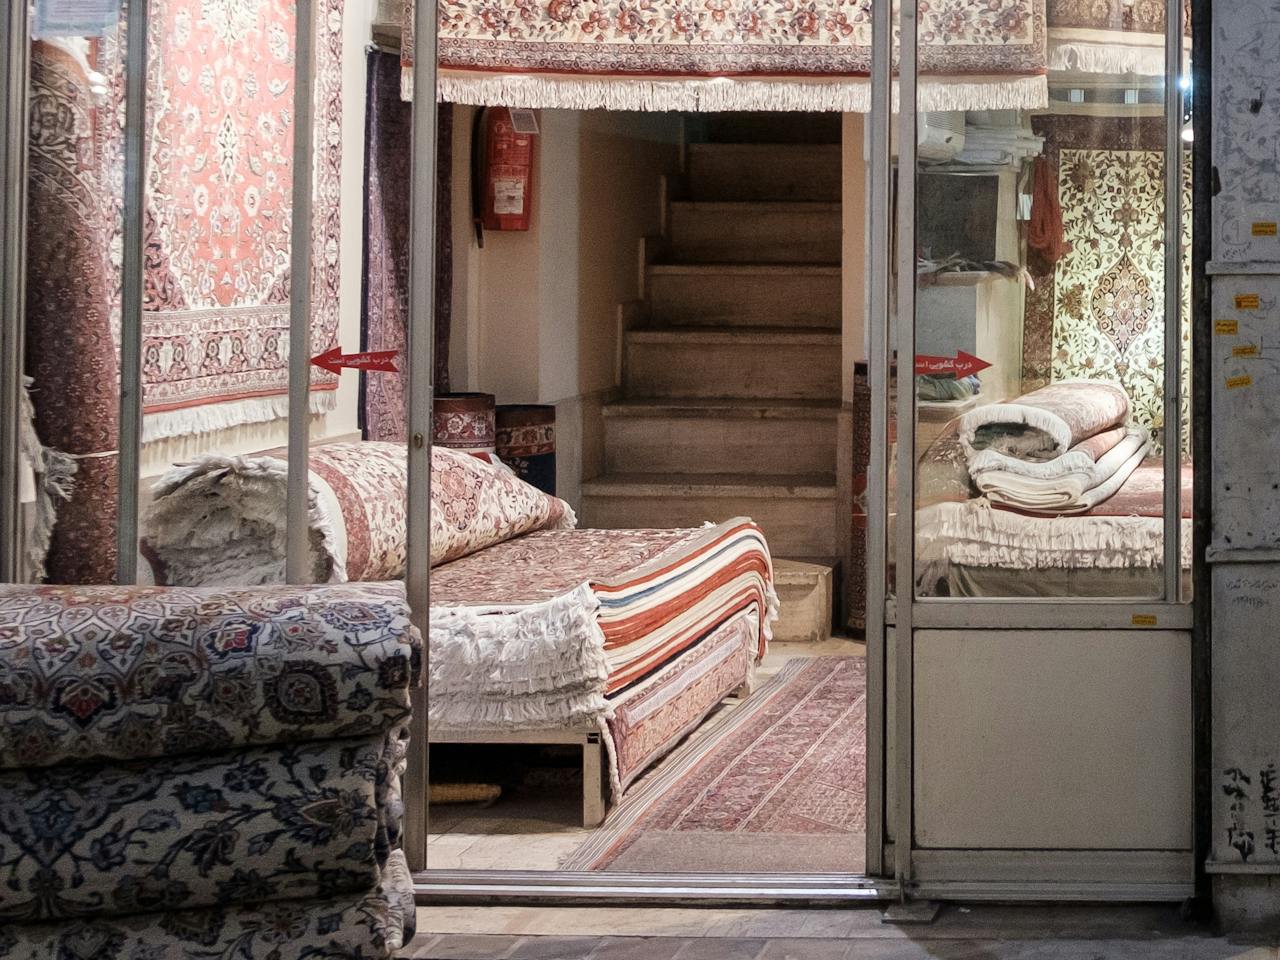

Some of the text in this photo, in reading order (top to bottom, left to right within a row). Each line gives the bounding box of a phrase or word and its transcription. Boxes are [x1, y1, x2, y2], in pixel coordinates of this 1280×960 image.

[916, 359, 972, 370] درب کشویی اس
